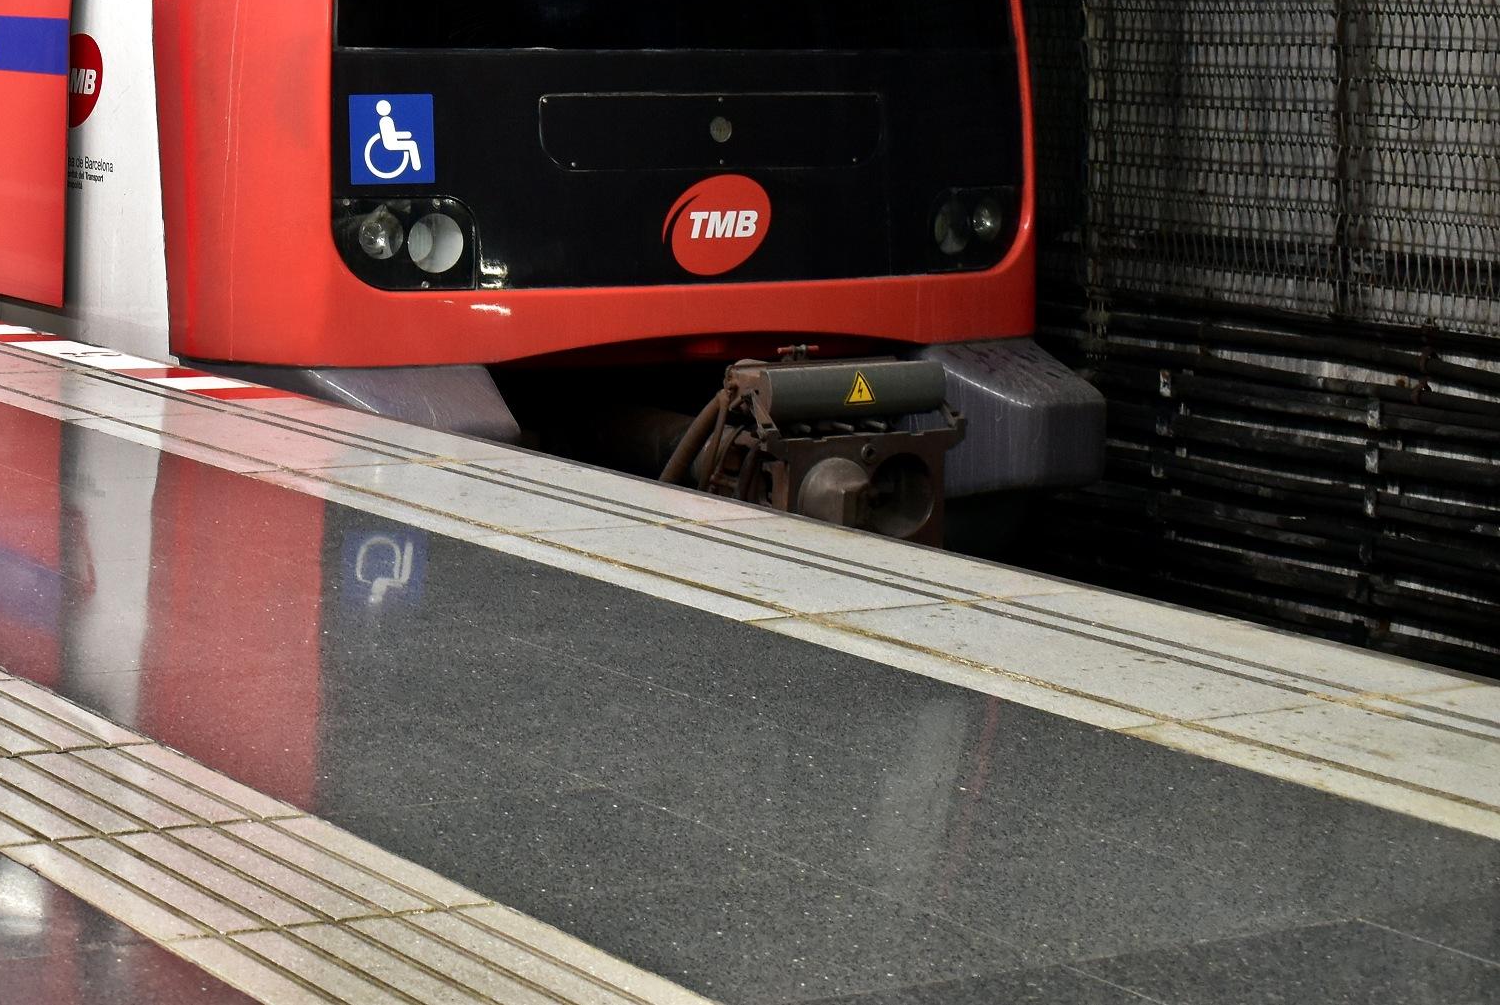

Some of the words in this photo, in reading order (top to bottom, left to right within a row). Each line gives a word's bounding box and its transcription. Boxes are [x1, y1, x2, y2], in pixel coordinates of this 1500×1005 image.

[69, 67, 97, 95] MB
[75, 156, 84, 169] de
[84, 156, 114, 173] Barcelona
[689, 209, 759, 239] TMB
